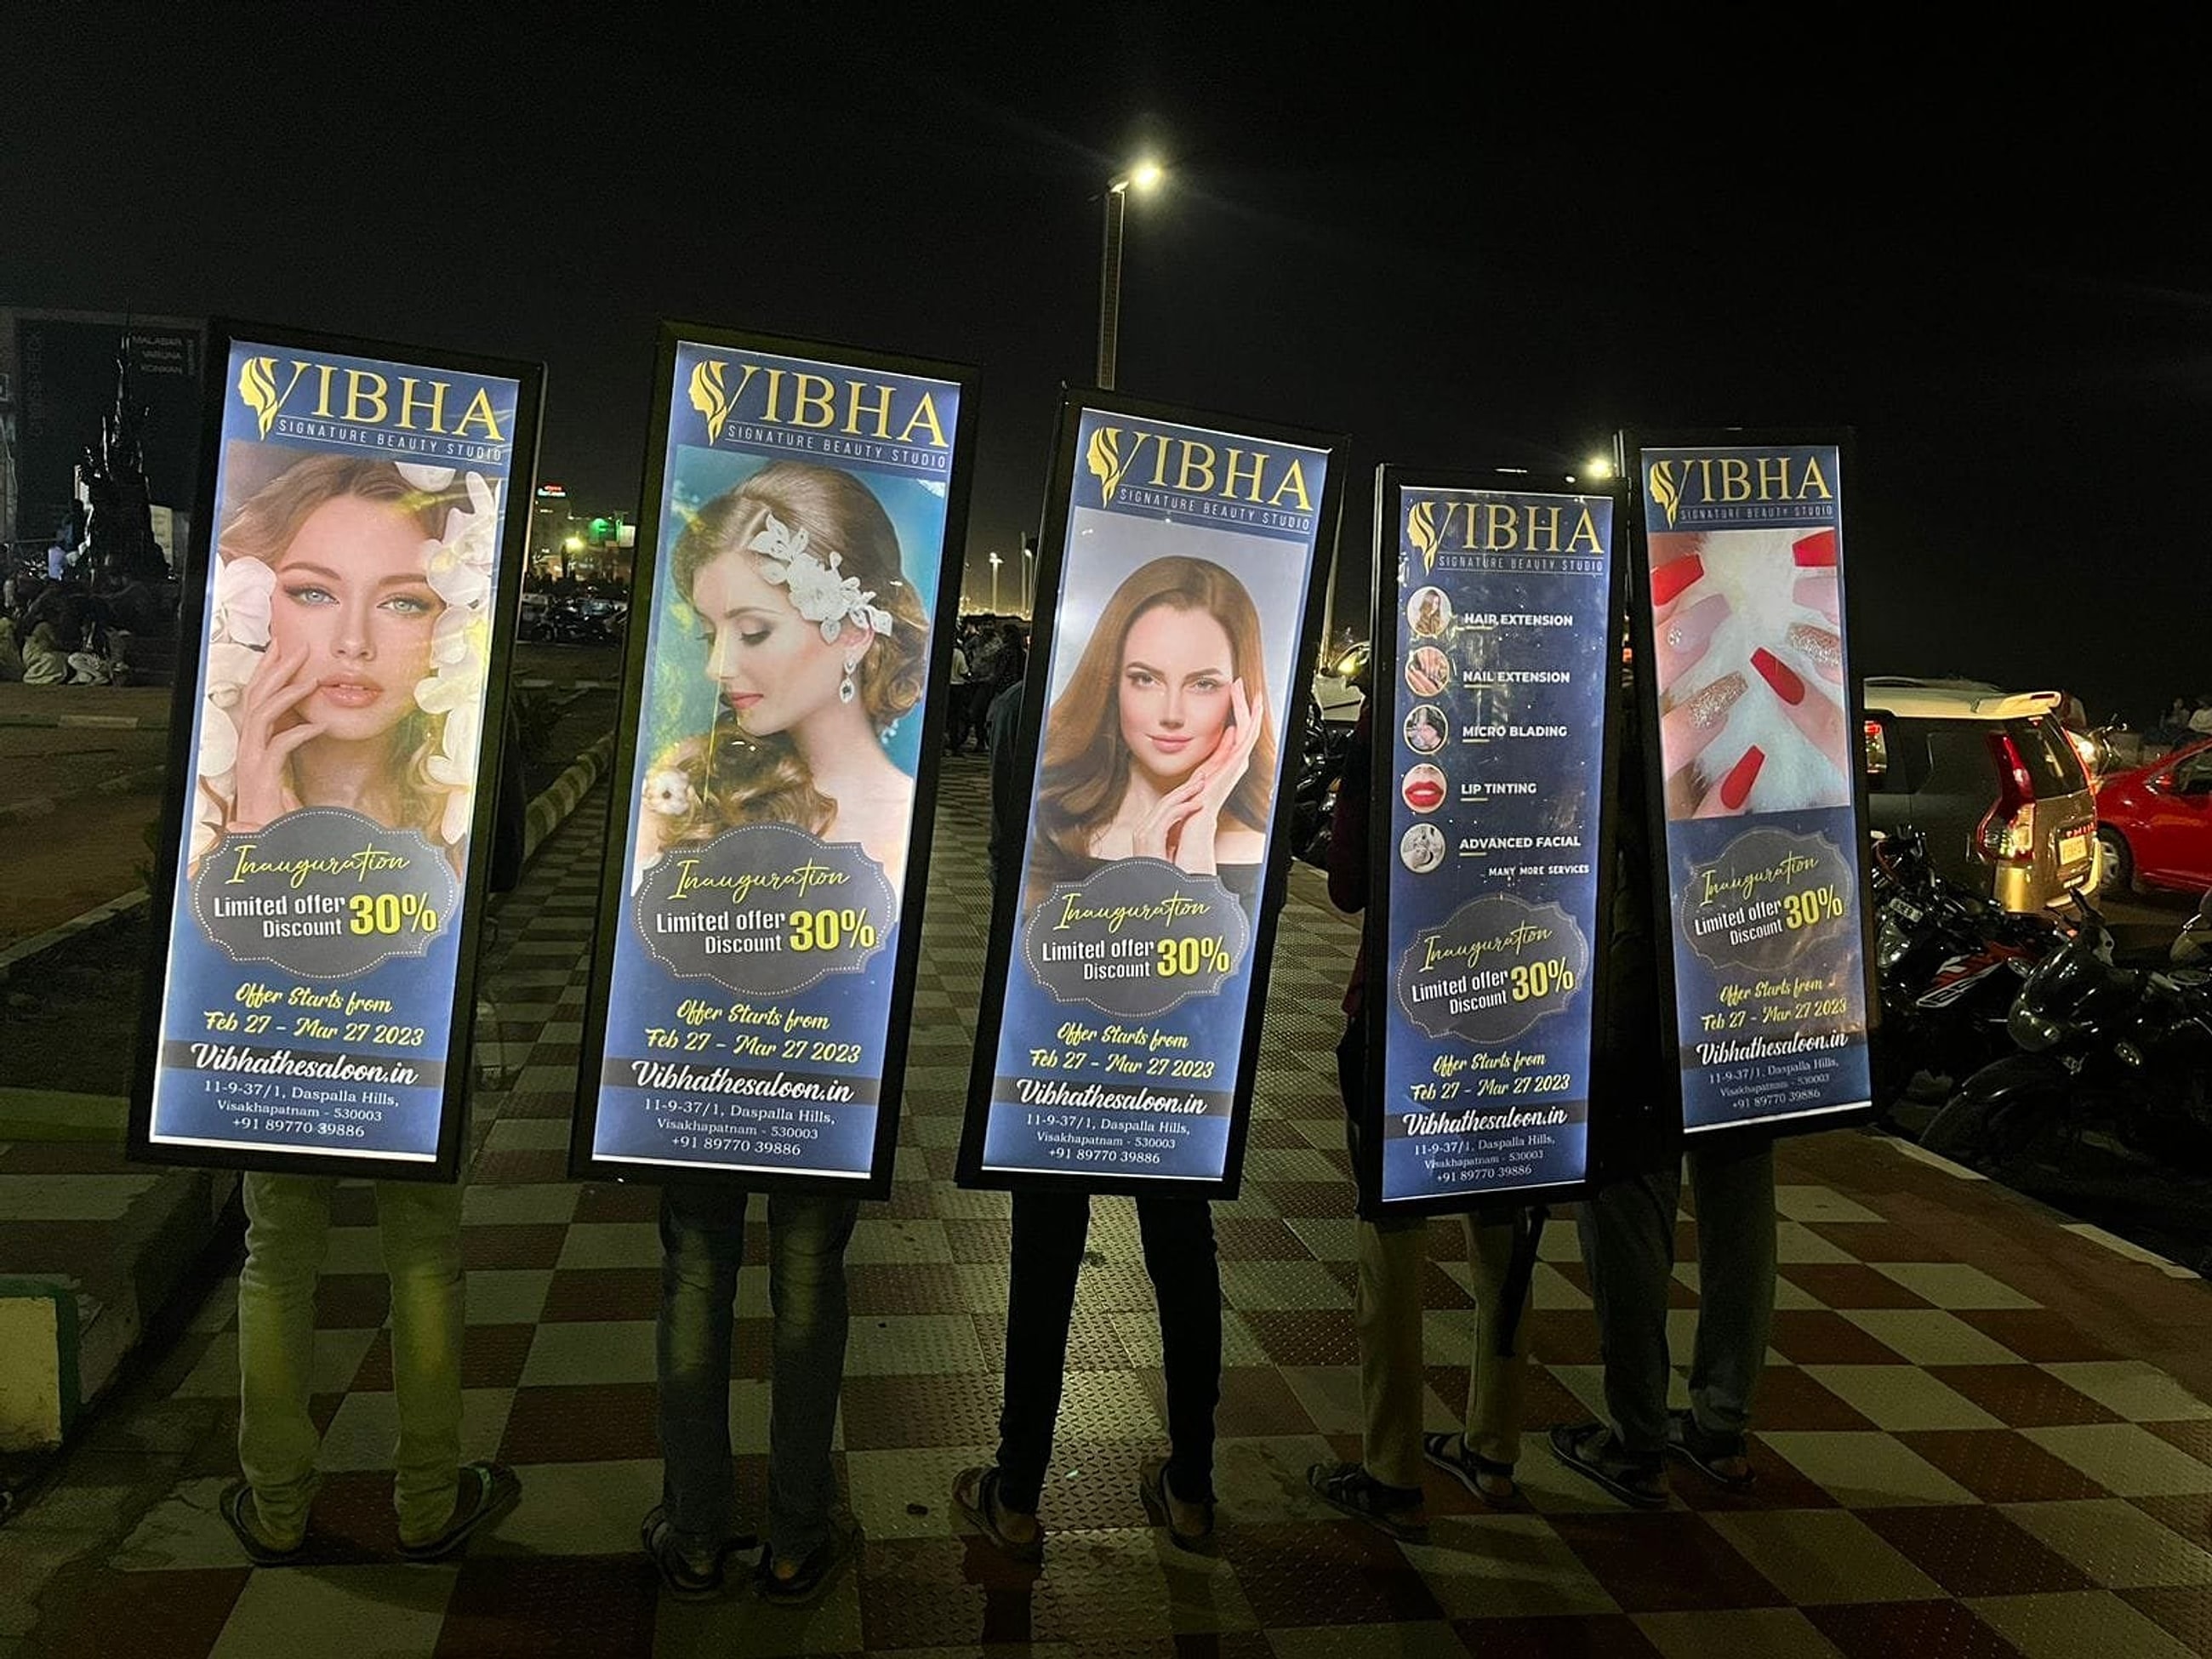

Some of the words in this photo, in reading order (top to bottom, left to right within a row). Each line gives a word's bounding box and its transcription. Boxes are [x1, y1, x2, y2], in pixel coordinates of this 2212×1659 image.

[258, 356, 505, 441] VIBHA
[708, 360, 949, 447] VIBHA
[279, 419, 366, 442] SIGNATURE
[378, 434, 436, 451] BEAUTY
[448, 444, 501, 461] STUDIO
[728, 425, 812, 448] SIGNATURE
[824, 439, 881, 458] BEAUTY
[892, 449, 944, 468] STUDIO
[1105, 427, 1313, 510] VIBHA
[1659, 457, 1833, 503] VIBHA
[1120, 488, 1194, 510] SIGNATURE
[1204, 502, 1254, 520] BEAUTY
[1263, 513, 1309, 530] STUDIO
[1420, 502, 1604, 553] VIBHA
[1440, 556, 1502, 567] SIGNATURE
[1511, 558, 1554, 570] BEAUTY
[1563, 560, 1602, 572] STUDIO
[1464, 613, 1497, 625] HAIR
[1501, 614, 1572, 625] EXTENSION
[1463, 671, 1494, 681] NAIL
[1497, 672, 1569, 682] EXTENSION
[1463, 725, 1506, 736] MICRO
[1510, 727, 1566, 736] BLADING
[1462, 784, 1480, 794] LIP
[1484, 783, 1536, 793] TINTING
[1460, 838, 1532, 849] ADVANCED
[1536, 836, 1581, 847] FACIAL
[225, 841, 410, 888] Inauguration
[1489, 867, 1515, 875] MANY
[1519, 866, 1543, 875] MORE
[1548, 864, 1589, 874] SERVICES
[667, 856, 850, 903] Inauguration
[1700, 851, 1818, 909] Inauguration
[214, 896, 287, 916] Limited
[294, 896, 345, 914] offer
[264, 919, 341, 938] Discount
[350, 892, 439, 934] 30%
[1053, 890, 1211, 932] Inauguration
[1695, 908, 1744, 935] Limited
[1749, 900, 1781, 921] offer
[1730, 920, 1782, 944] Discount
[1784, 885, 1842, 927] 30%
[657, 911, 728, 932] Limited
[737, 911, 784, 929] offer
[706, 935, 781, 953] Discount
[790, 907, 877, 951] 30%
[1043, 940, 1104, 961] Limited
[1112, 940, 1154, 957] offer
[1084, 961, 1149, 979] Discount
[1158, 936, 1232, 975] 30%
[1419, 921, 1552, 972] Inauguration
[236, 983, 282, 1007] Offer
[288, 987, 344, 1008] Starts
[345, 992, 392, 1015] from
[1412, 976, 1466, 1001] Limited
[1472, 971, 1508, 989] offer
[1450, 990, 1506, 1014] Discount
[1511, 956, 1575, 1000] 30%
[1720, 985, 1750, 1006] Offer
[1755, 978, 1790, 997] Starts
[1793, 978, 1822, 997] from
[677, 1000, 721, 1025] Offer
[728, 1004, 782, 1025] Starts
[784, 1009, 830, 1032] from
[1702, 1013, 1724, 1030] Feb
[1730, 1011, 1746, 1028] 27
[1763, 1006, 1791, 1023] Mar
[1795, 1002, 1810, 1018] 27
[1815, 997, 1846, 1016] 2023
[204, 1012, 237, 1030] Feb
[246, 1015, 271, 1033] 27
[294, 1018, 338, 1038] Mar
[344, 1023, 370, 1040] 27
[373, 1024, 424, 1046] 2023
[1058, 1023, 1097, 1046] Offer
[1101, 1025, 1148, 1045] Starts
[1149, 1029, 1188, 1051] from
[645, 1029, 678, 1048] Feb
[686, 1032, 710, 1050] 27
[733, 1035, 776, 1055] Mar
[783, 1040, 807, 1058] 27
[812, 1042, 861, 1063] 2023
[1696, 1029, 1848, 1064] Vibhathesaloon.in
[191, 1043, 419, 1084] Vibhathesaloon.in
[1030, 1050, 1057, 1067] Feb
[1064, 1052, 1086, 1069] 27
[1106, 1054, 1142, 1072] Mar
[1147, 1058, 1169, 1075] 27
[1172, 1060, 1214, 1078] 2023
[1434, 1055, 1467, 1077] Offer
[1471, 1052, 1511, 1069] Starts
[1514, 1051, 1544, 1071] from
[1710, 1068, 1764, 1083] 11-9-37/1,
[206, 1080, 286, 1097] 11-9-37/1,
[293, 1087, 356, 1103] Daspalla
[362, 1092, 398, 1106] Hills,
[631, 1061, 854, 1102] Vibhathesaloon.in
[1411, 1083, 1435, 1100] Feb
[1442, 1082, 1459, 1098] 27
[1477, 1079, 1508, 1096] Mar
[1514, 1077, 1531, 1093] 27
[1534, 1074, 1570, 1092] 2023
[218, 1100, 319, 1116] Visakhapatnam
[334, 1108, 381, 1120] 530003
[646, 1098, 725, 1116] 11-9-37/1,
[731, 1105, 792, 1120] Daspalla
[800, 1109, 835, 1124] Hills,
[1017, 1079, 1207, 1114] Vibhathesaloon.in
[233, 1118, 257, 1129] +91
[265, 1120, 312, 1132] 89770
[318, 1123, 364, 1137] 39886
[658, 1118, 756, 1134] Visakhapatnam
[771, 1126, 818, 1138] 530003
[1028, 1114, 1096, 1129] 11-9-37/1,
[1101, 1119, 1154, 1132] Daspalla
[1160, 1121, 1189, 1135] Hills,
[1403, 1106, 1567, 1135] Vibhathesaloon.in
[672, 1137, 696, 1148] +91
[704, 1138, 750, 1150] 89770
[755, 1142, 800, 1154] 39886
[1038, 1132, 1122, 1145] Visakhapatnam
[1135, 1137, 1175, 1148] 530003
[1416, 1142, 1474, 1155] 11-9-37/1,
[1479, 1137, 1524, 1150] Daspalla
[1528, 1134, 1554, 1144] Hills,
[1050, 1148, 1069, 1159] +91
[1077, 1149, 1116, 1160] 89770
[1120, 1152, 1159, 1163] 39886
[1509, 1150, 1542, 1160] 530003
[1438, 1172, 1455, 1181] +91
[1460, 1169, 1494, 1181] 89770
[1498, 1164, 1531, 1177] 39886
